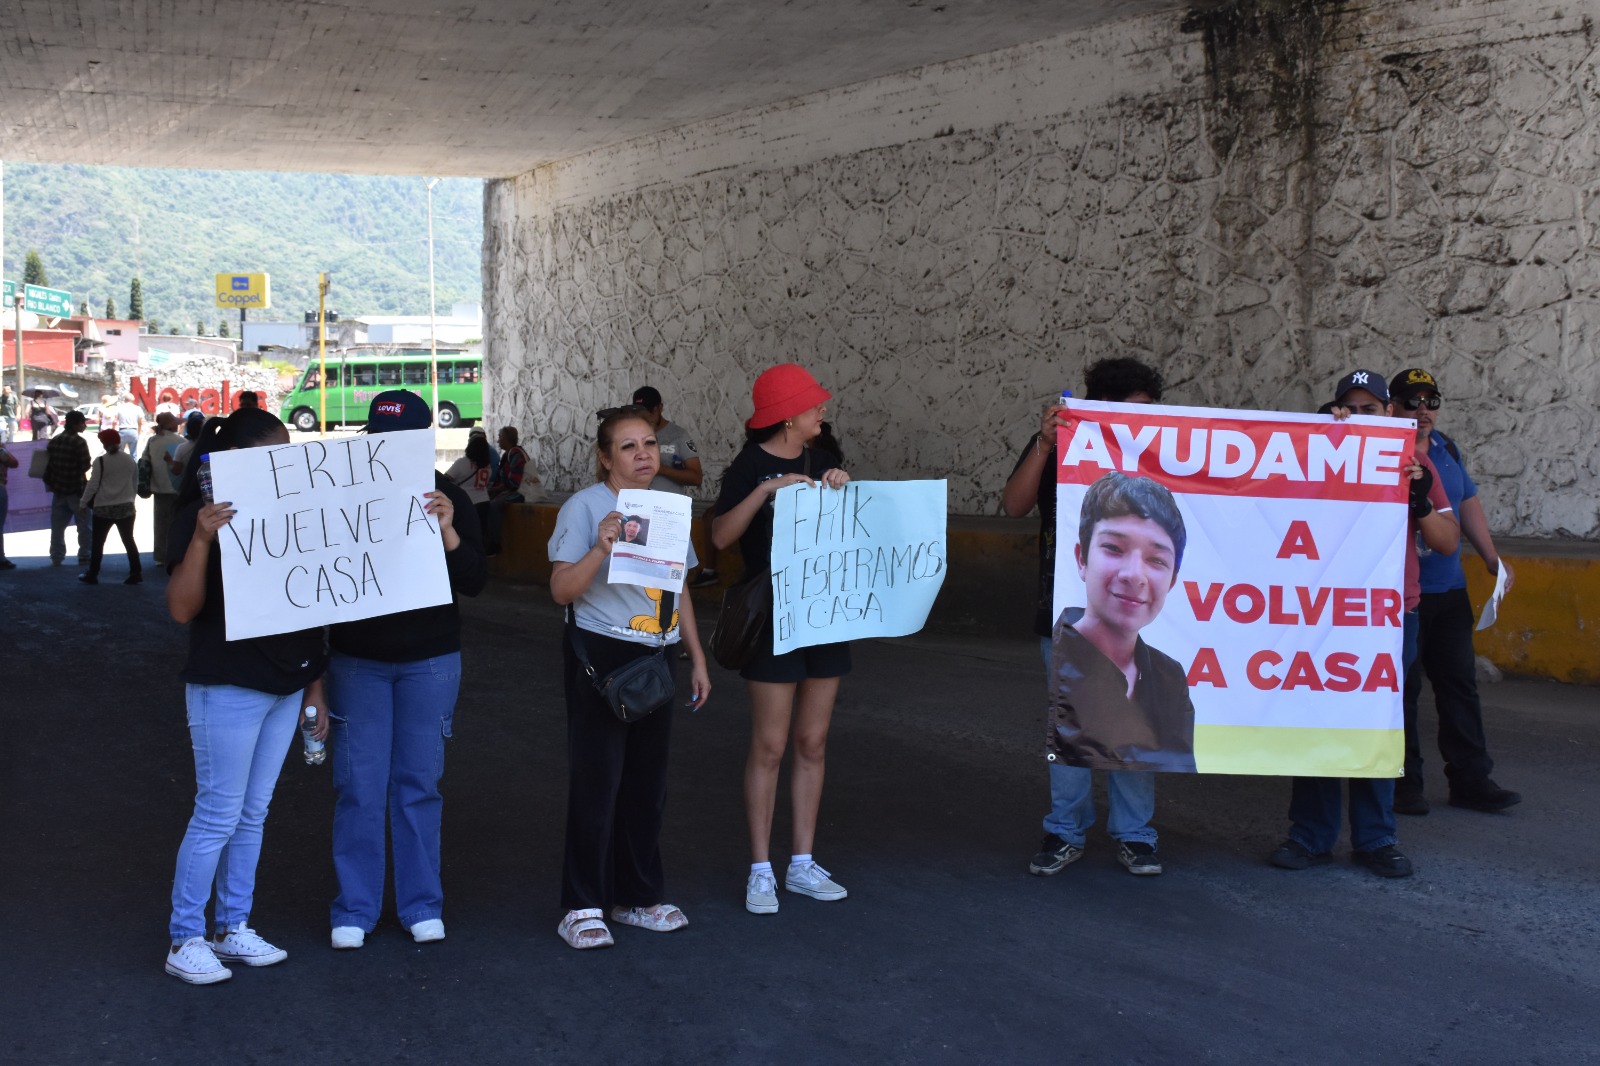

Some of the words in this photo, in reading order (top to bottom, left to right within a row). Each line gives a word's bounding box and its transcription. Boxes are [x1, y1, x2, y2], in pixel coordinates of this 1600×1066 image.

[218, 292, 262, 305] Coppel
[1352, 372, 1369, 384] NY
[267, 439, 393, 500] ERIK
[1062, 420, 1405, 486] AYUDAME
[227, 498, 386, 566] VUELVE
[406, 495, 436, 536] A
[794, 485, 872, 554] ERIK
[1276, 520, 1320, 560] A
[285, 552, 384, 609] CASA
[772, 566, 791, 609] TE
[801, 541, 942, 600] ESPERAMOS
[779, 606, 796, 641] EN
[1184, 581, 1402, 627] VOLVER
[1187, 648, 1228, 688] A
[1246, 650, 1399, 692] CASA
